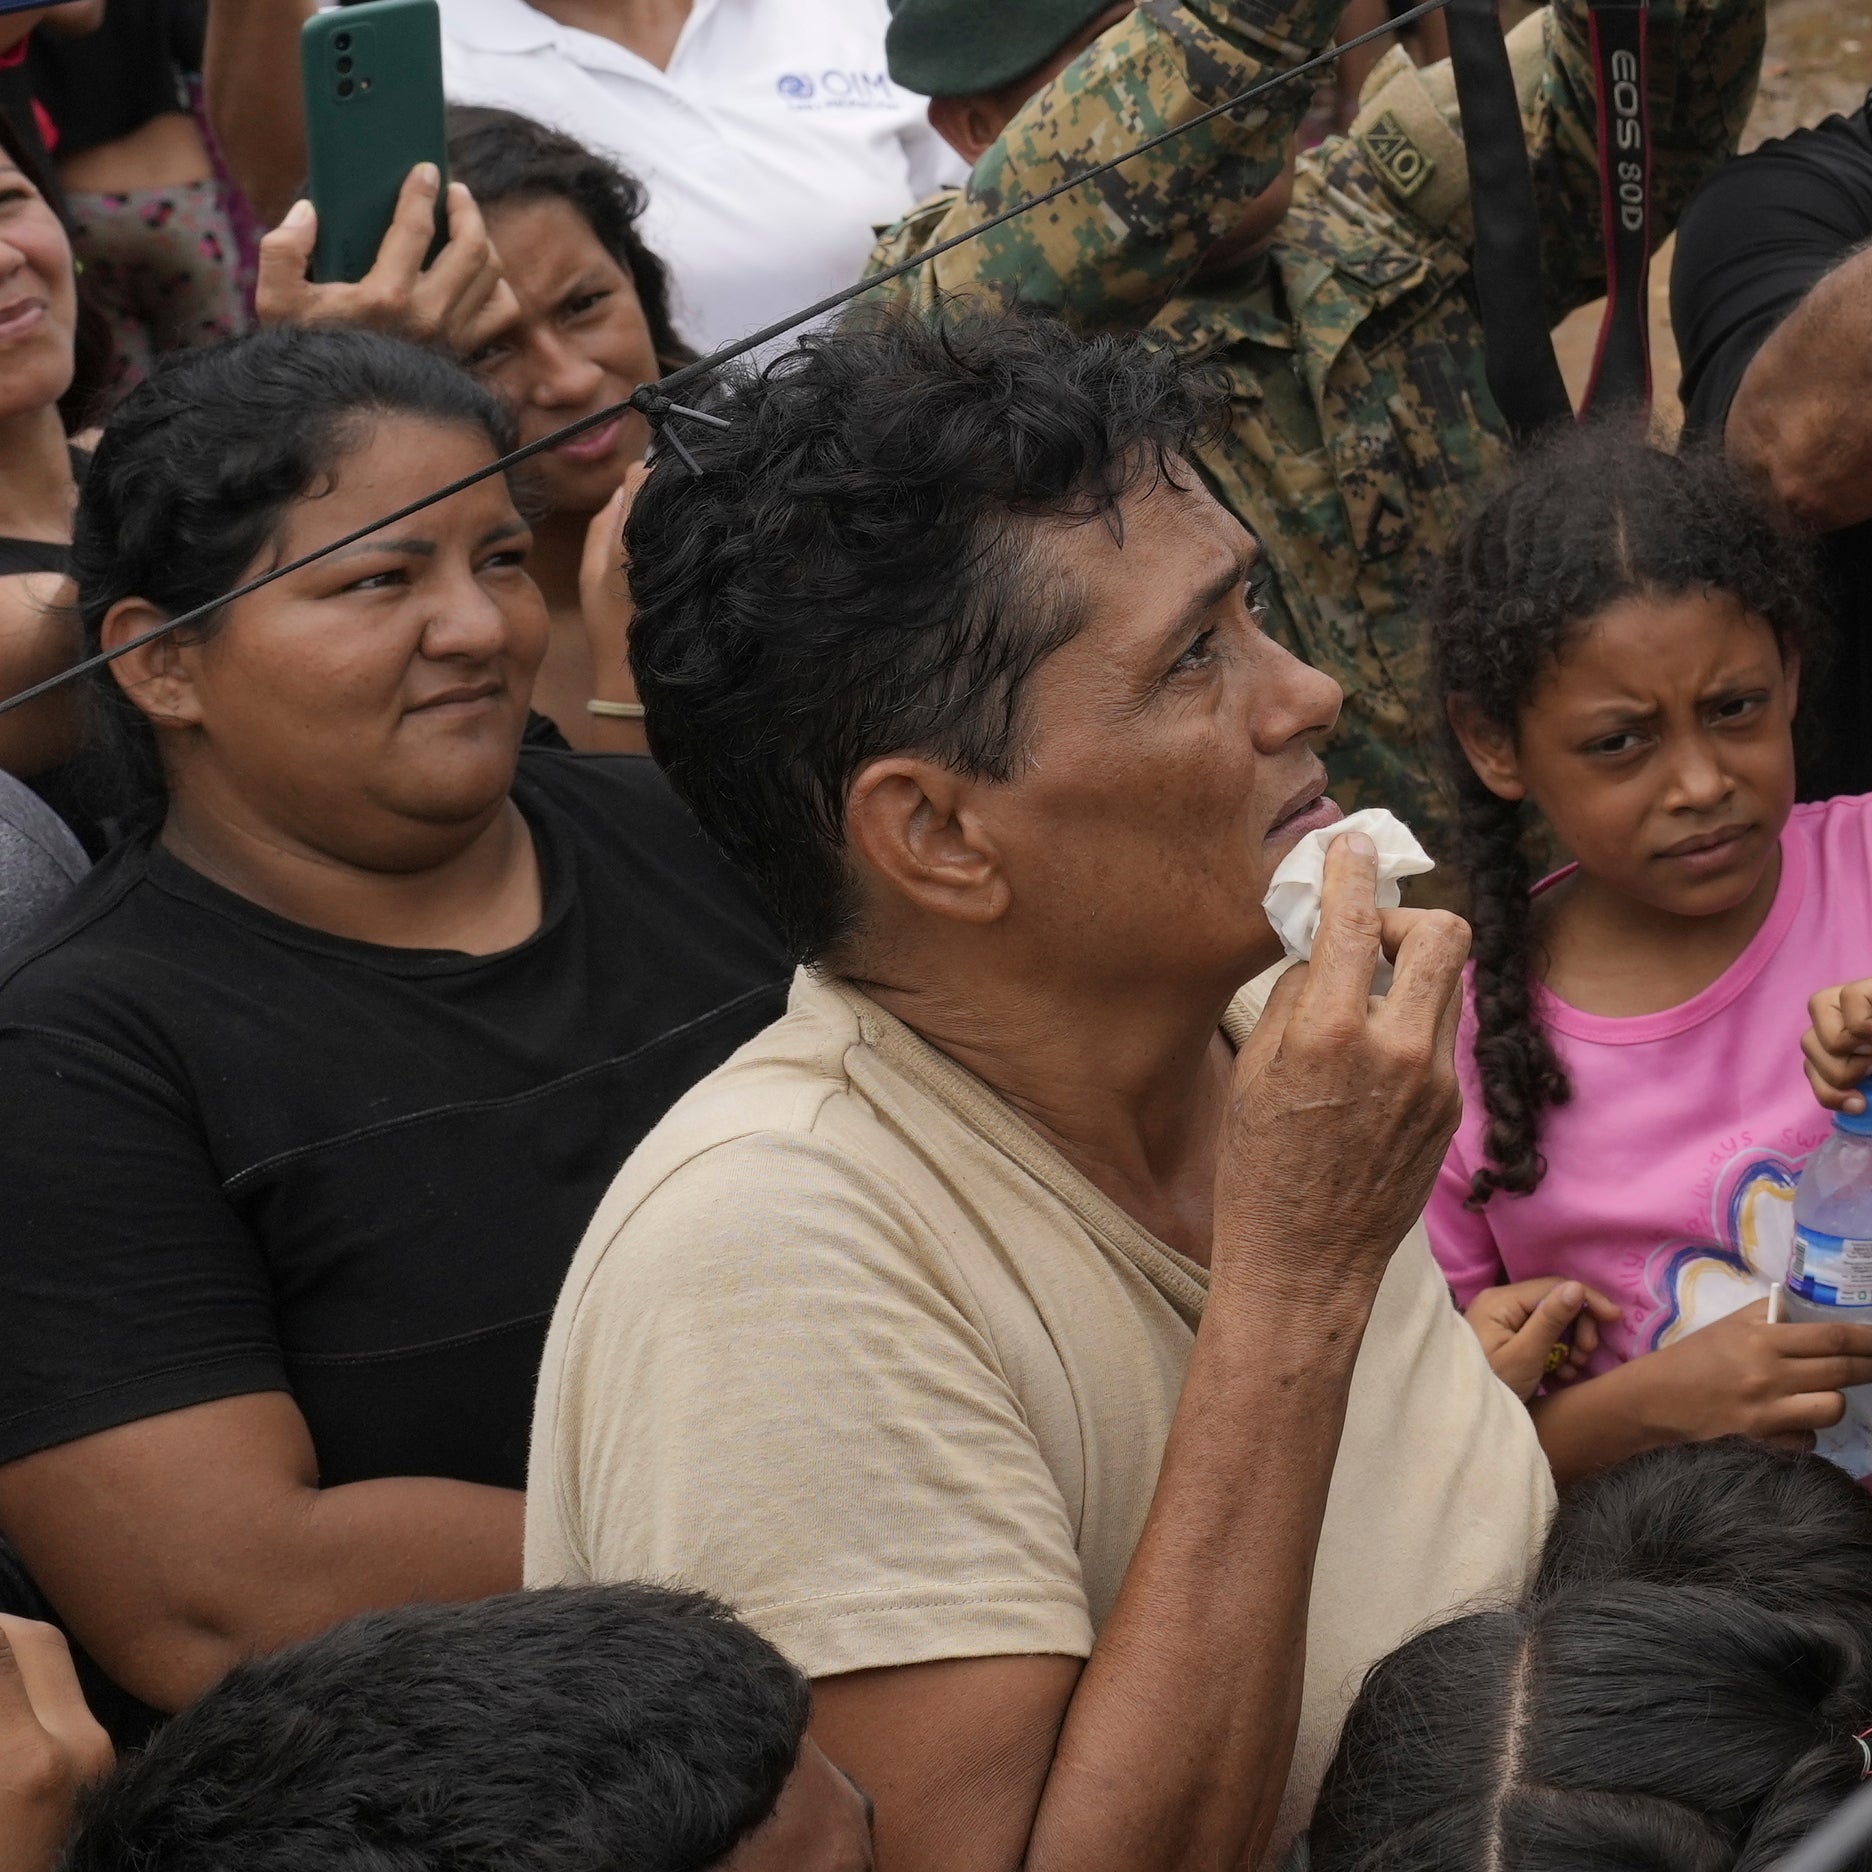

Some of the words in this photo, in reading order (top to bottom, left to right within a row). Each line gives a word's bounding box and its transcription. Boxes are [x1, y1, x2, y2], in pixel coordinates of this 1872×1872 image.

[821, 70, 893, 99] OIM
[1612, 49, 1641, 150] EOS
[1618, 161, 1644, 231] 80D
